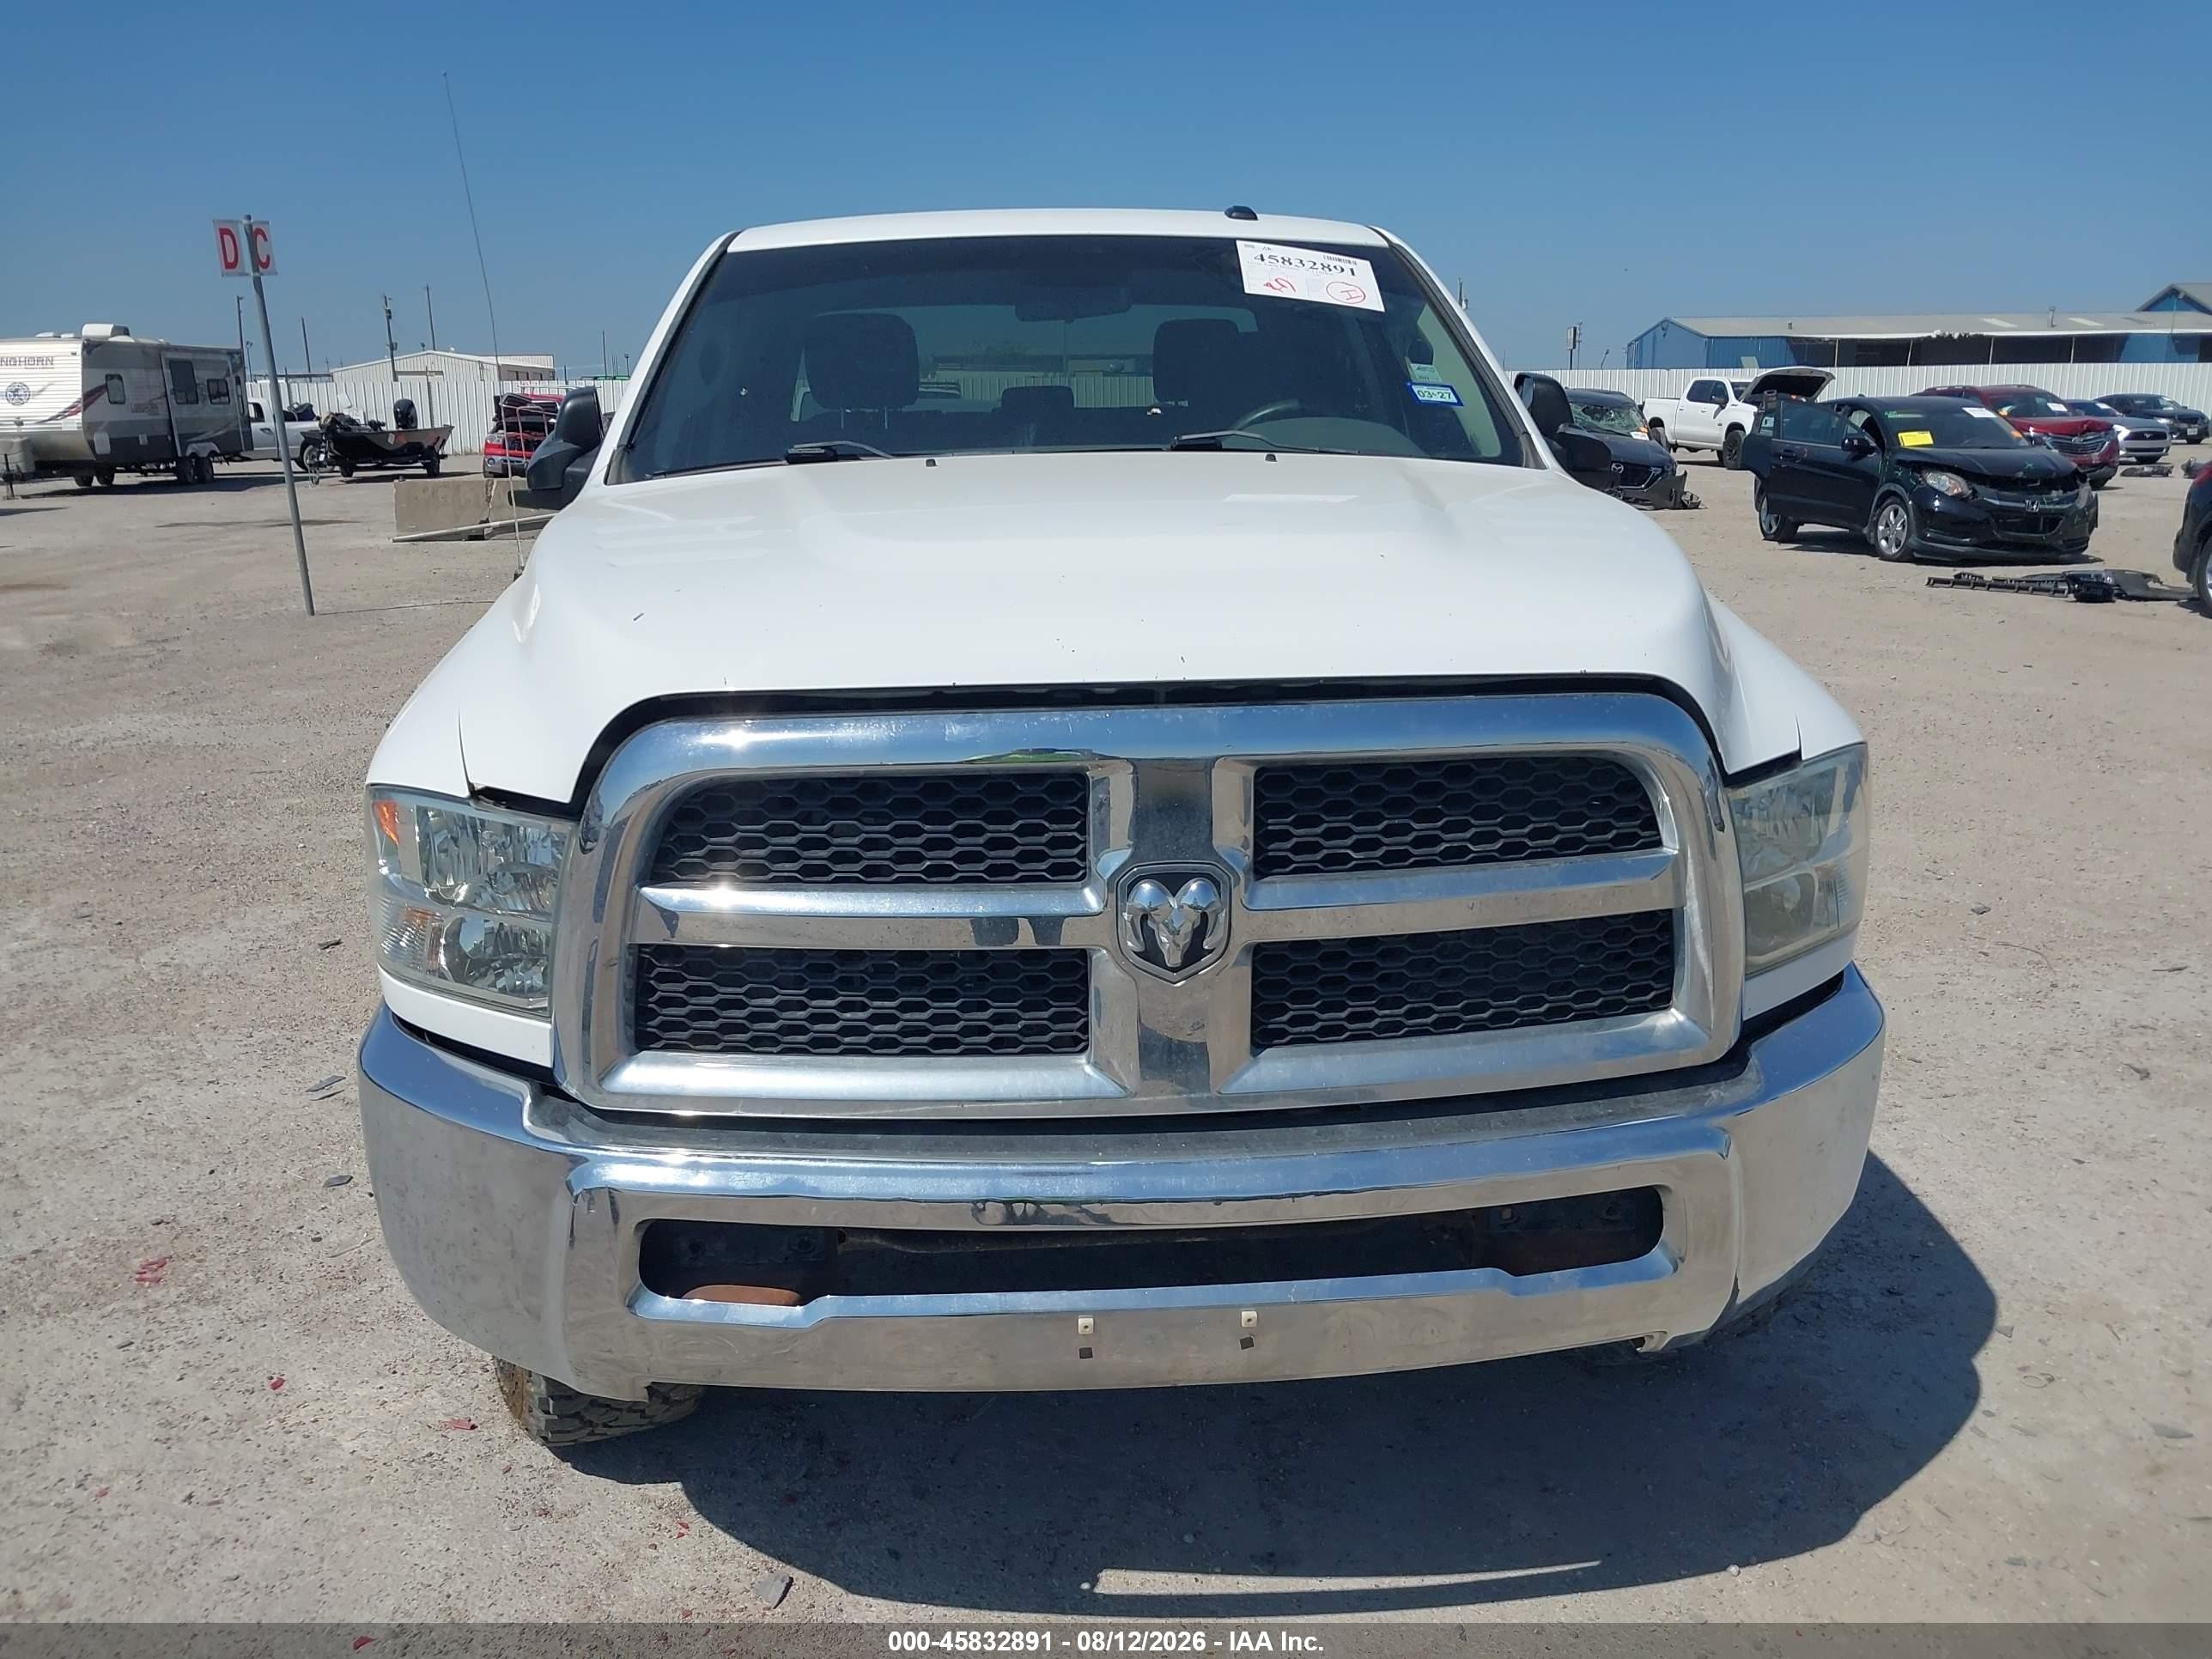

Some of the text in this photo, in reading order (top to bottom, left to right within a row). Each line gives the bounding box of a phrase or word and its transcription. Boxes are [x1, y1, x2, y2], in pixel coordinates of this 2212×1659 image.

[218, 227, 239, 270] D
[253, 227, 270, 270] C
[1254, 253, 1357, 276] 45832891
